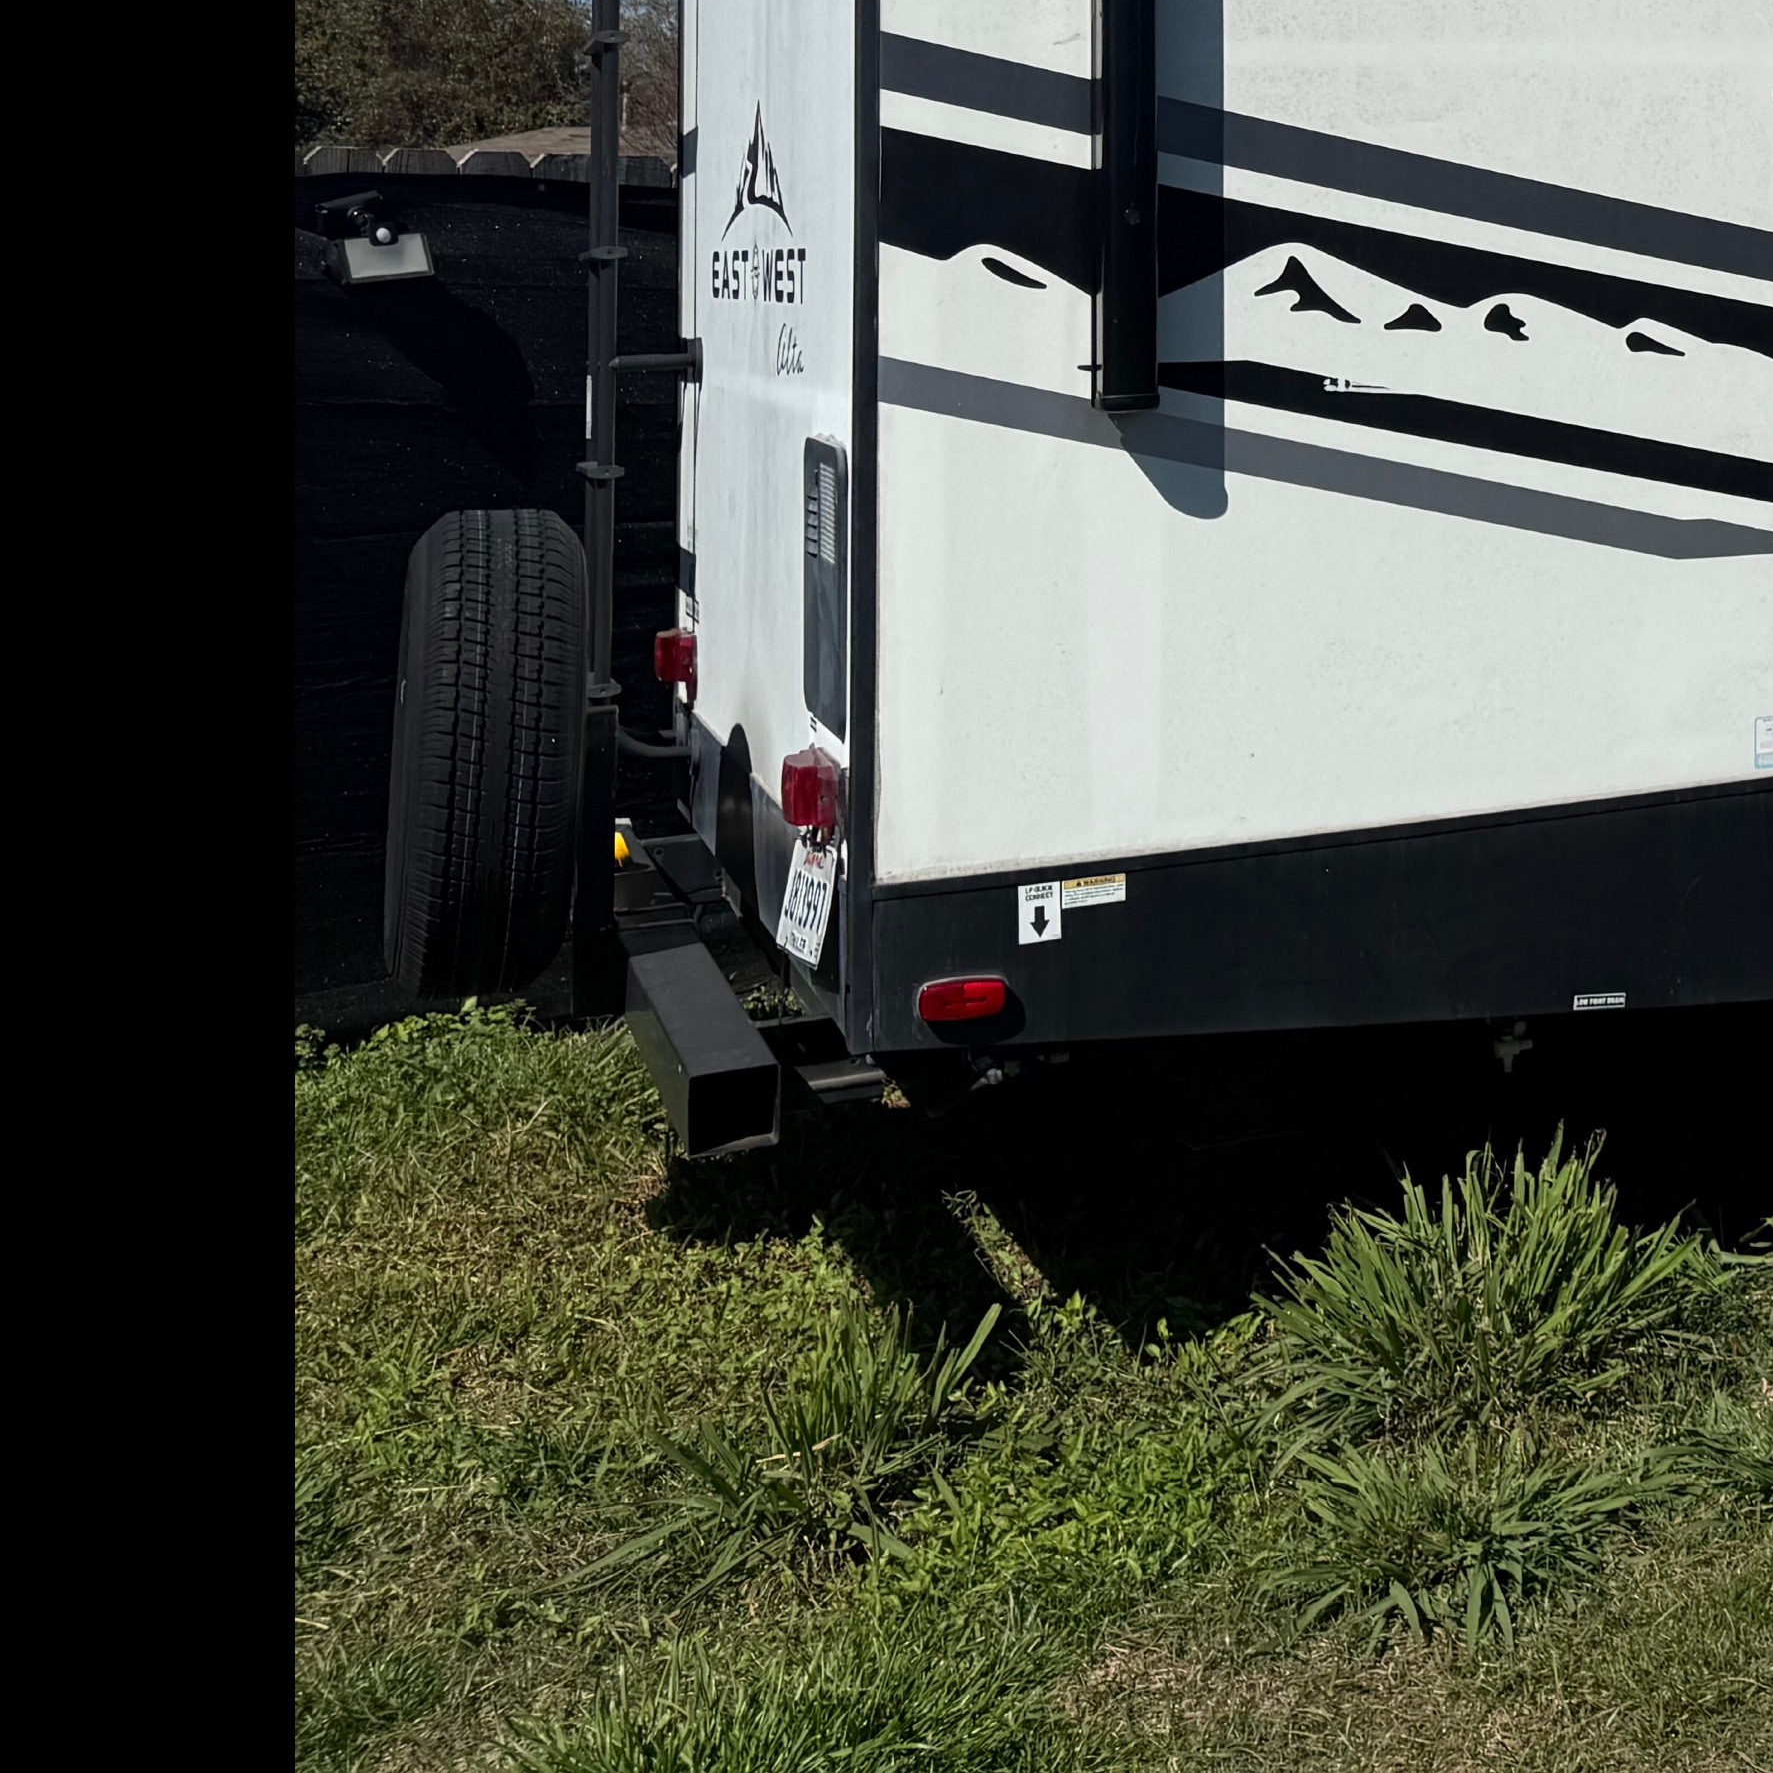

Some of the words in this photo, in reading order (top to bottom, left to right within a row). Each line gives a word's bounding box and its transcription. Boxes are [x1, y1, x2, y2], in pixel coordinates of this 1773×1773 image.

[712, 250, 748, 300] EAST
[762, 248, 806, 304] WEST
[777, 323, 804, 376] Alta
